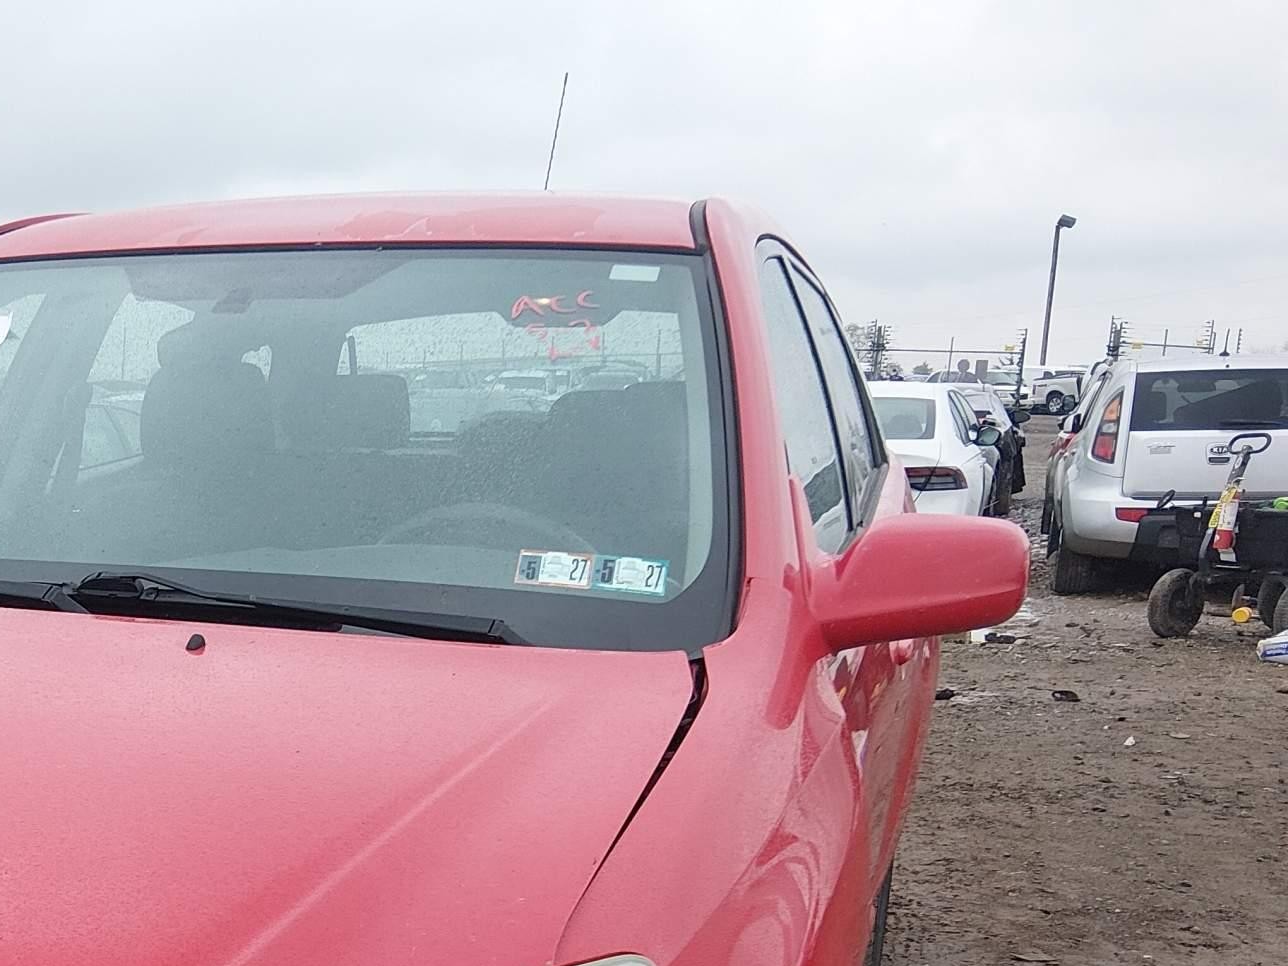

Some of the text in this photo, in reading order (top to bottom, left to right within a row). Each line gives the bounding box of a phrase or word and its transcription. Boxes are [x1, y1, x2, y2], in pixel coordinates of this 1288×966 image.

[511, 289, 600, 320] ACC
[525, 558, 588, 584] 5 27
[600, 559, 663, 590] 5 27
